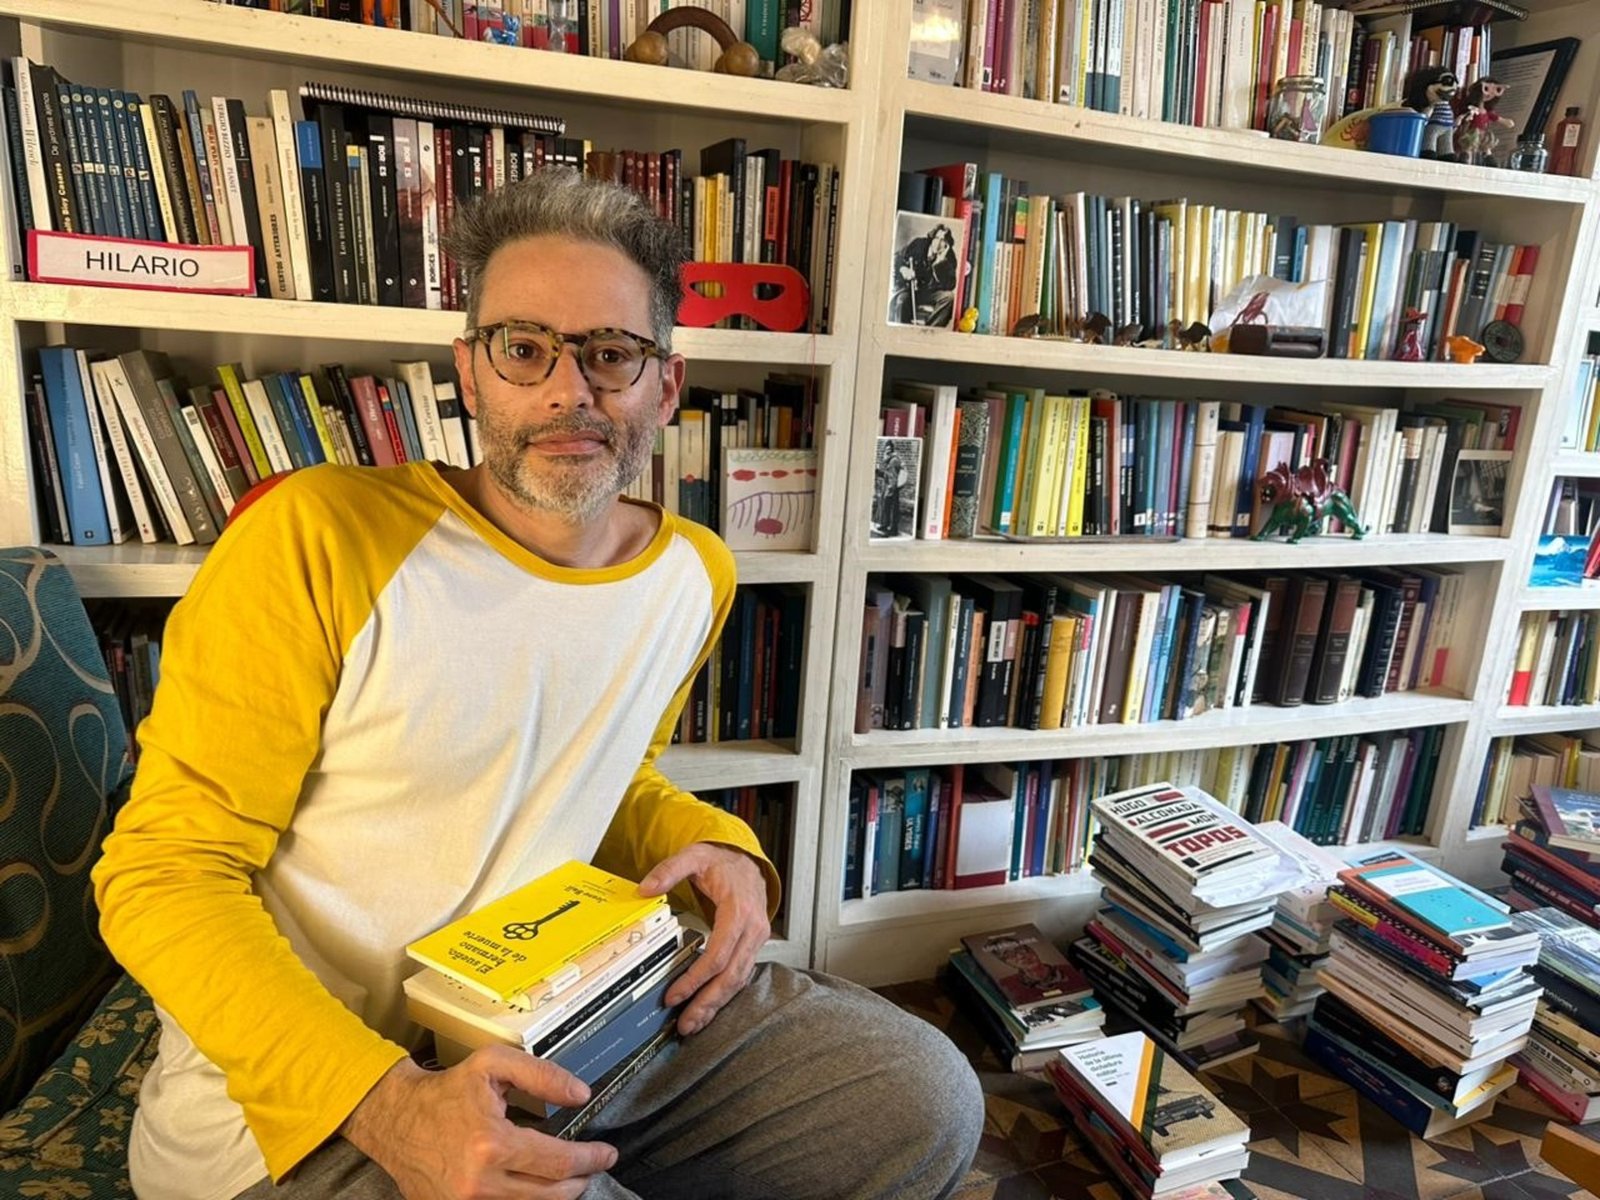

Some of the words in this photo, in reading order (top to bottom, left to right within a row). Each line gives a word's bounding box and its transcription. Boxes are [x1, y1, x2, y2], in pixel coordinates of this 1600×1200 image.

[40, 91, 53, 116] ajenos
[216, 103, 227, 131] SERGIO
[45, 116, 58, 145] jardines
[50, 145, 59, 156] De
[221, 132, 231, 158] BIZZIO
[53, 161, 66, 195] Casares
[226, 166, 237, 193] PLANET
[471, 155, 484, 187] BORGES
[509, 151, 520, 184] BORGES
[59, 196, 71, 215] Bioy
[269, 213, 282, 258] ANTERIORES
[85, 249, 200, 278] HILARIO
[275, 260, 286, 292] CUENTOS
[426, 253, 437, 283] BORGES
[425, 425, 437, 442] Julio
[1110, 799, 1148, 817] HUGO
[1136, 802, 1203, 825] ALCONADA
[1189, 812, 1219, 826] MON
[904, 817, 913, 850] ULYSSES
[1164, 825, 1248, 858] TOPOS
[459, 941, 506, 966] hermano
[462, 929, 506, 952] muerte
[500, 945, 515, 956] la
[475, 961, 495, 975] El
[511, 951, 527, 962] de
